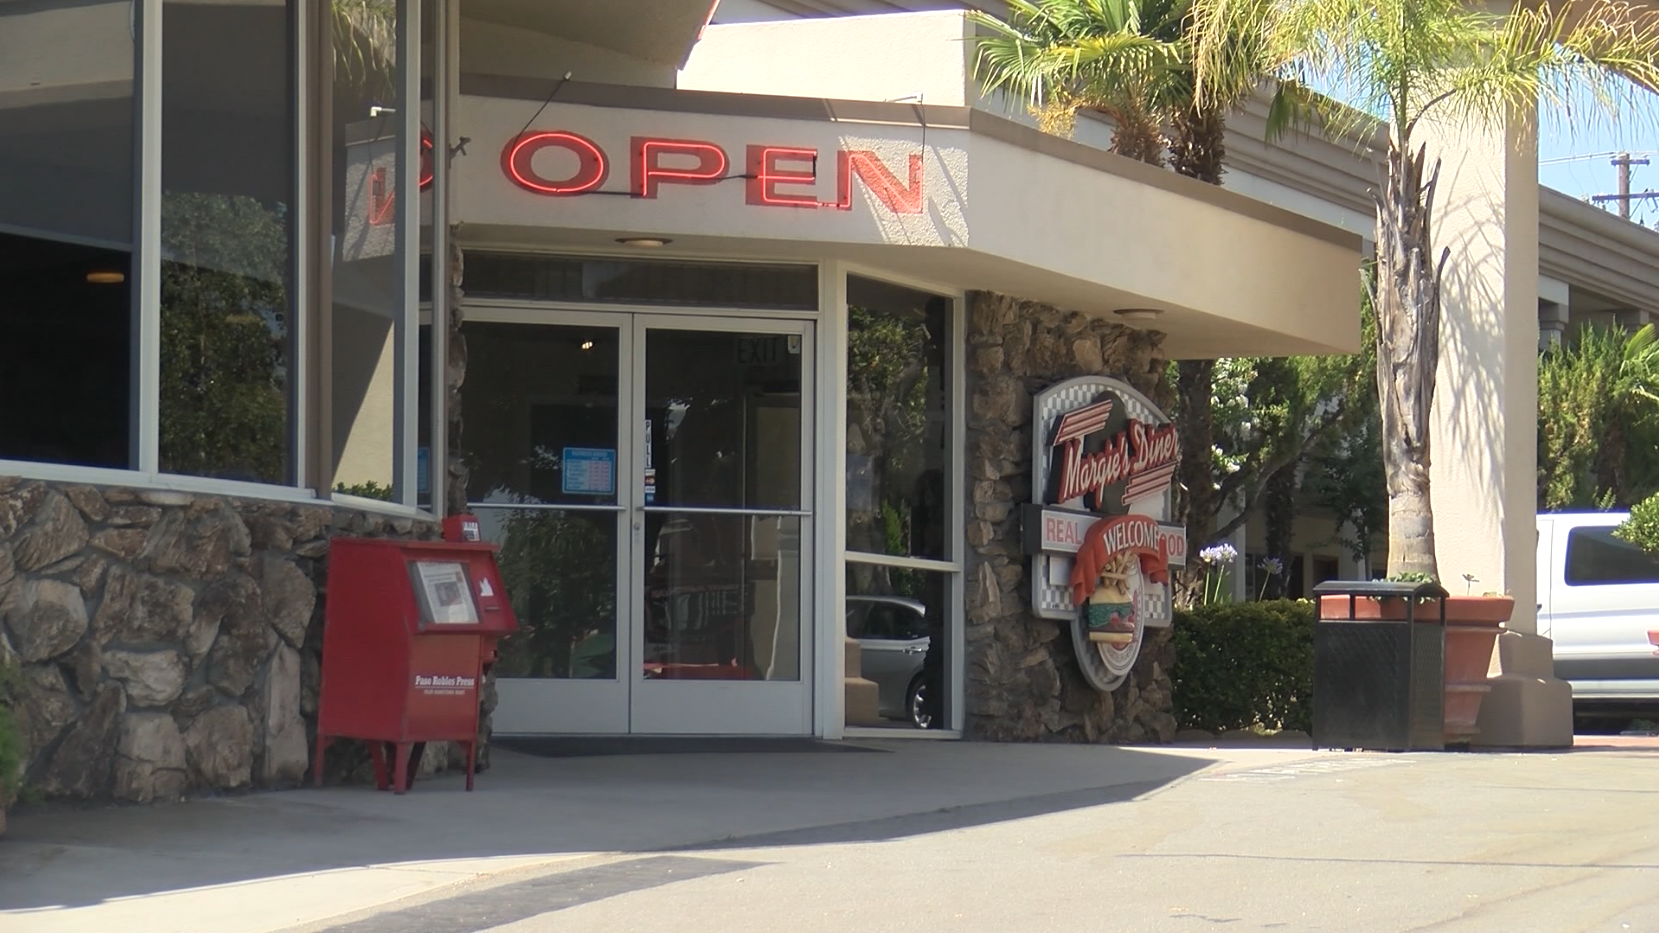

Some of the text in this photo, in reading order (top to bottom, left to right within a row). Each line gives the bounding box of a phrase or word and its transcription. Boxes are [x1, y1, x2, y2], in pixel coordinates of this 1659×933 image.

[500, 130, 924, 214] OPEN
[737, 337, 778, 363] EXIT
[1060, 421, 1180, 506] Margie's Diner
[1046, 517, 1083, 545] REAL
[1103, 520, 1160, 556] WELCOME
[415, 675, 475, 686] Paso Robles Press
